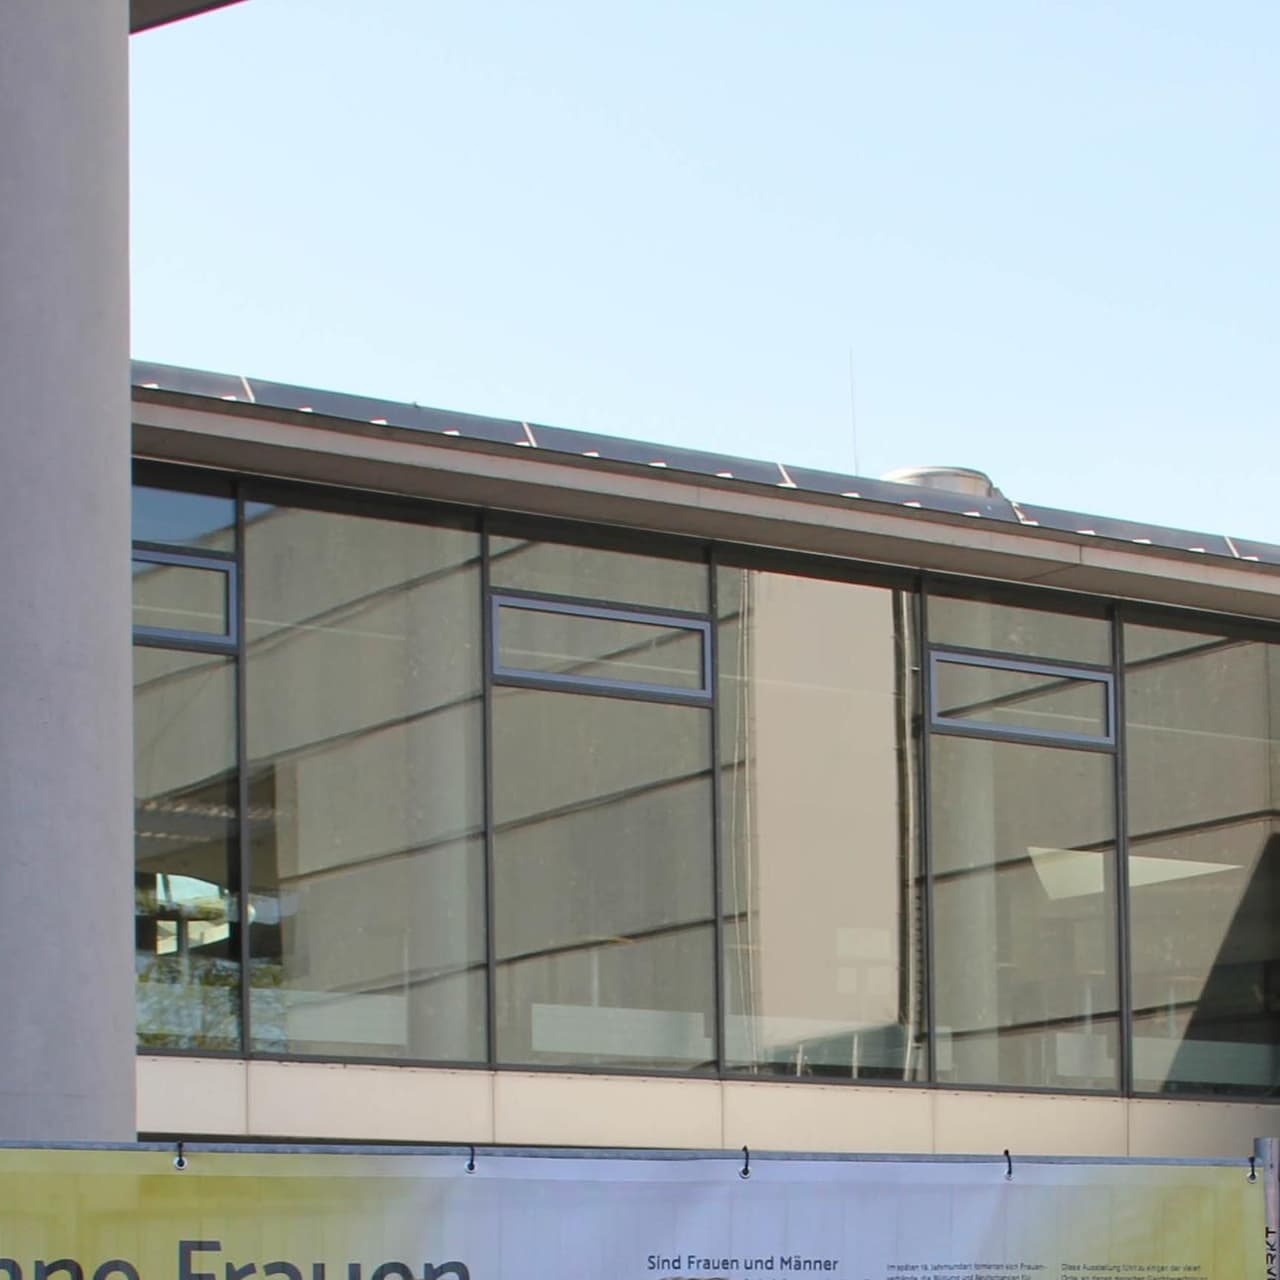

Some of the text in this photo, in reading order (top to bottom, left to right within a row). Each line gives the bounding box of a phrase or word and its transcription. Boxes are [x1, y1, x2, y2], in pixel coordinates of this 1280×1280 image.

[648, 1255, 839, 1271] Sind Frauen und Männer
